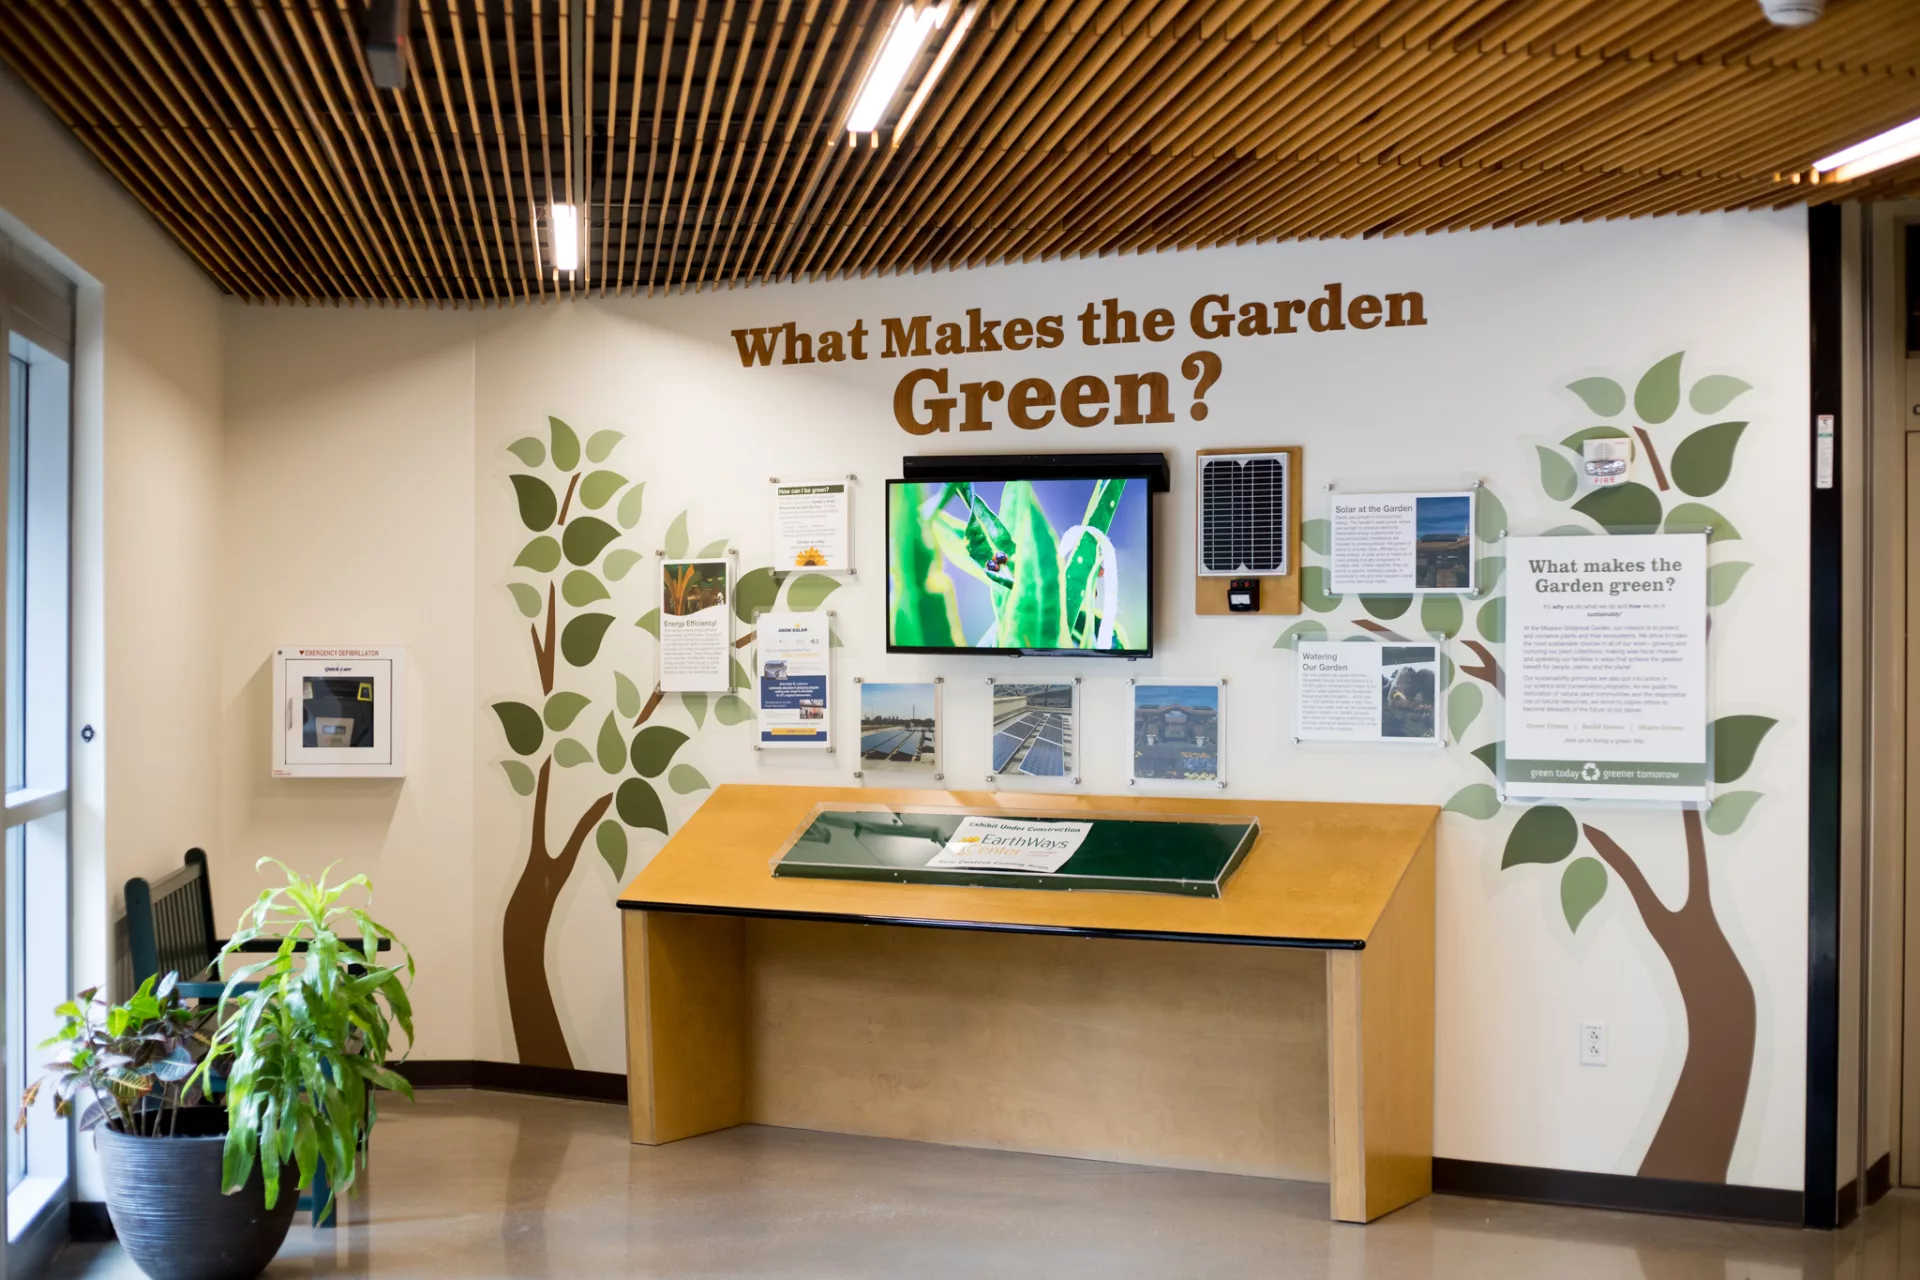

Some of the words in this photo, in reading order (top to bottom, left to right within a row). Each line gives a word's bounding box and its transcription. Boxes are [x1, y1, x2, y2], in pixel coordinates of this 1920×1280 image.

[731, 318, 868, 367] What
[881, 308, 1064, 358] Makes
[1078, 298, 1175, 346] the
[1190, 283, 1428, 340] Garden
[894, 350, 1223, 435] Green?
[1528, 559, 1578, 573] What
[1584, 559, 1646, 572] makes
[1651, 558, 1682, 572] the
[1535, 579, 1604, 593] Garden
[1609, 577, 1676, 596] green?
[1303, 653, 1338, 662] Watering
[1530, 770, 1554, 779] green
[1556, 768, 1580, 779] today
[1603, 770, 1634, 779] greener
[1637, 770, 1679, 779] tomorrow
[958, 843, 1020, 856] Center
[981, 833, 1069, 850] EarthWays
